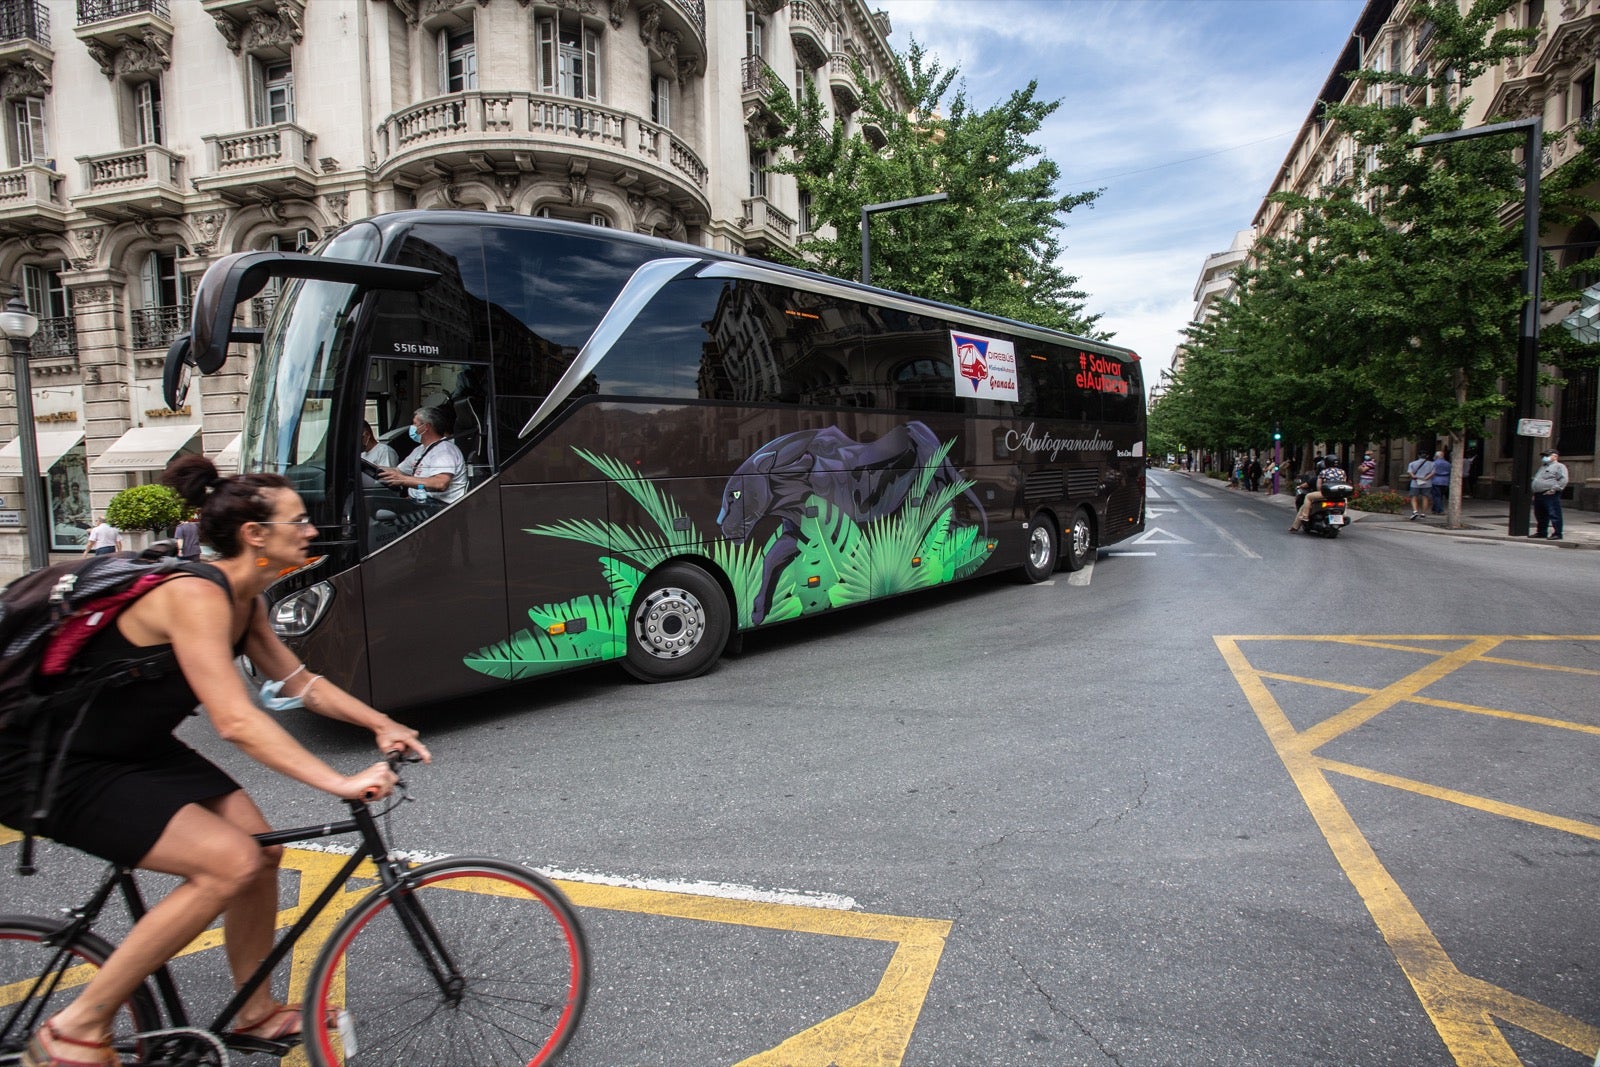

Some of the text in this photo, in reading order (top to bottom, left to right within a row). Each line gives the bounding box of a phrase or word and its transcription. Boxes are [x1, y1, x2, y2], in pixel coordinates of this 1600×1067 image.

[394, 343, 439, 355] S 516 HDH
[1089, 353, 1121, 377] Salvar
[989, 375, 1015, 390] Granada
[1075, 369, 1128, 394] elAutocar
[1005, 422, 1114, 462] Autogranadina
